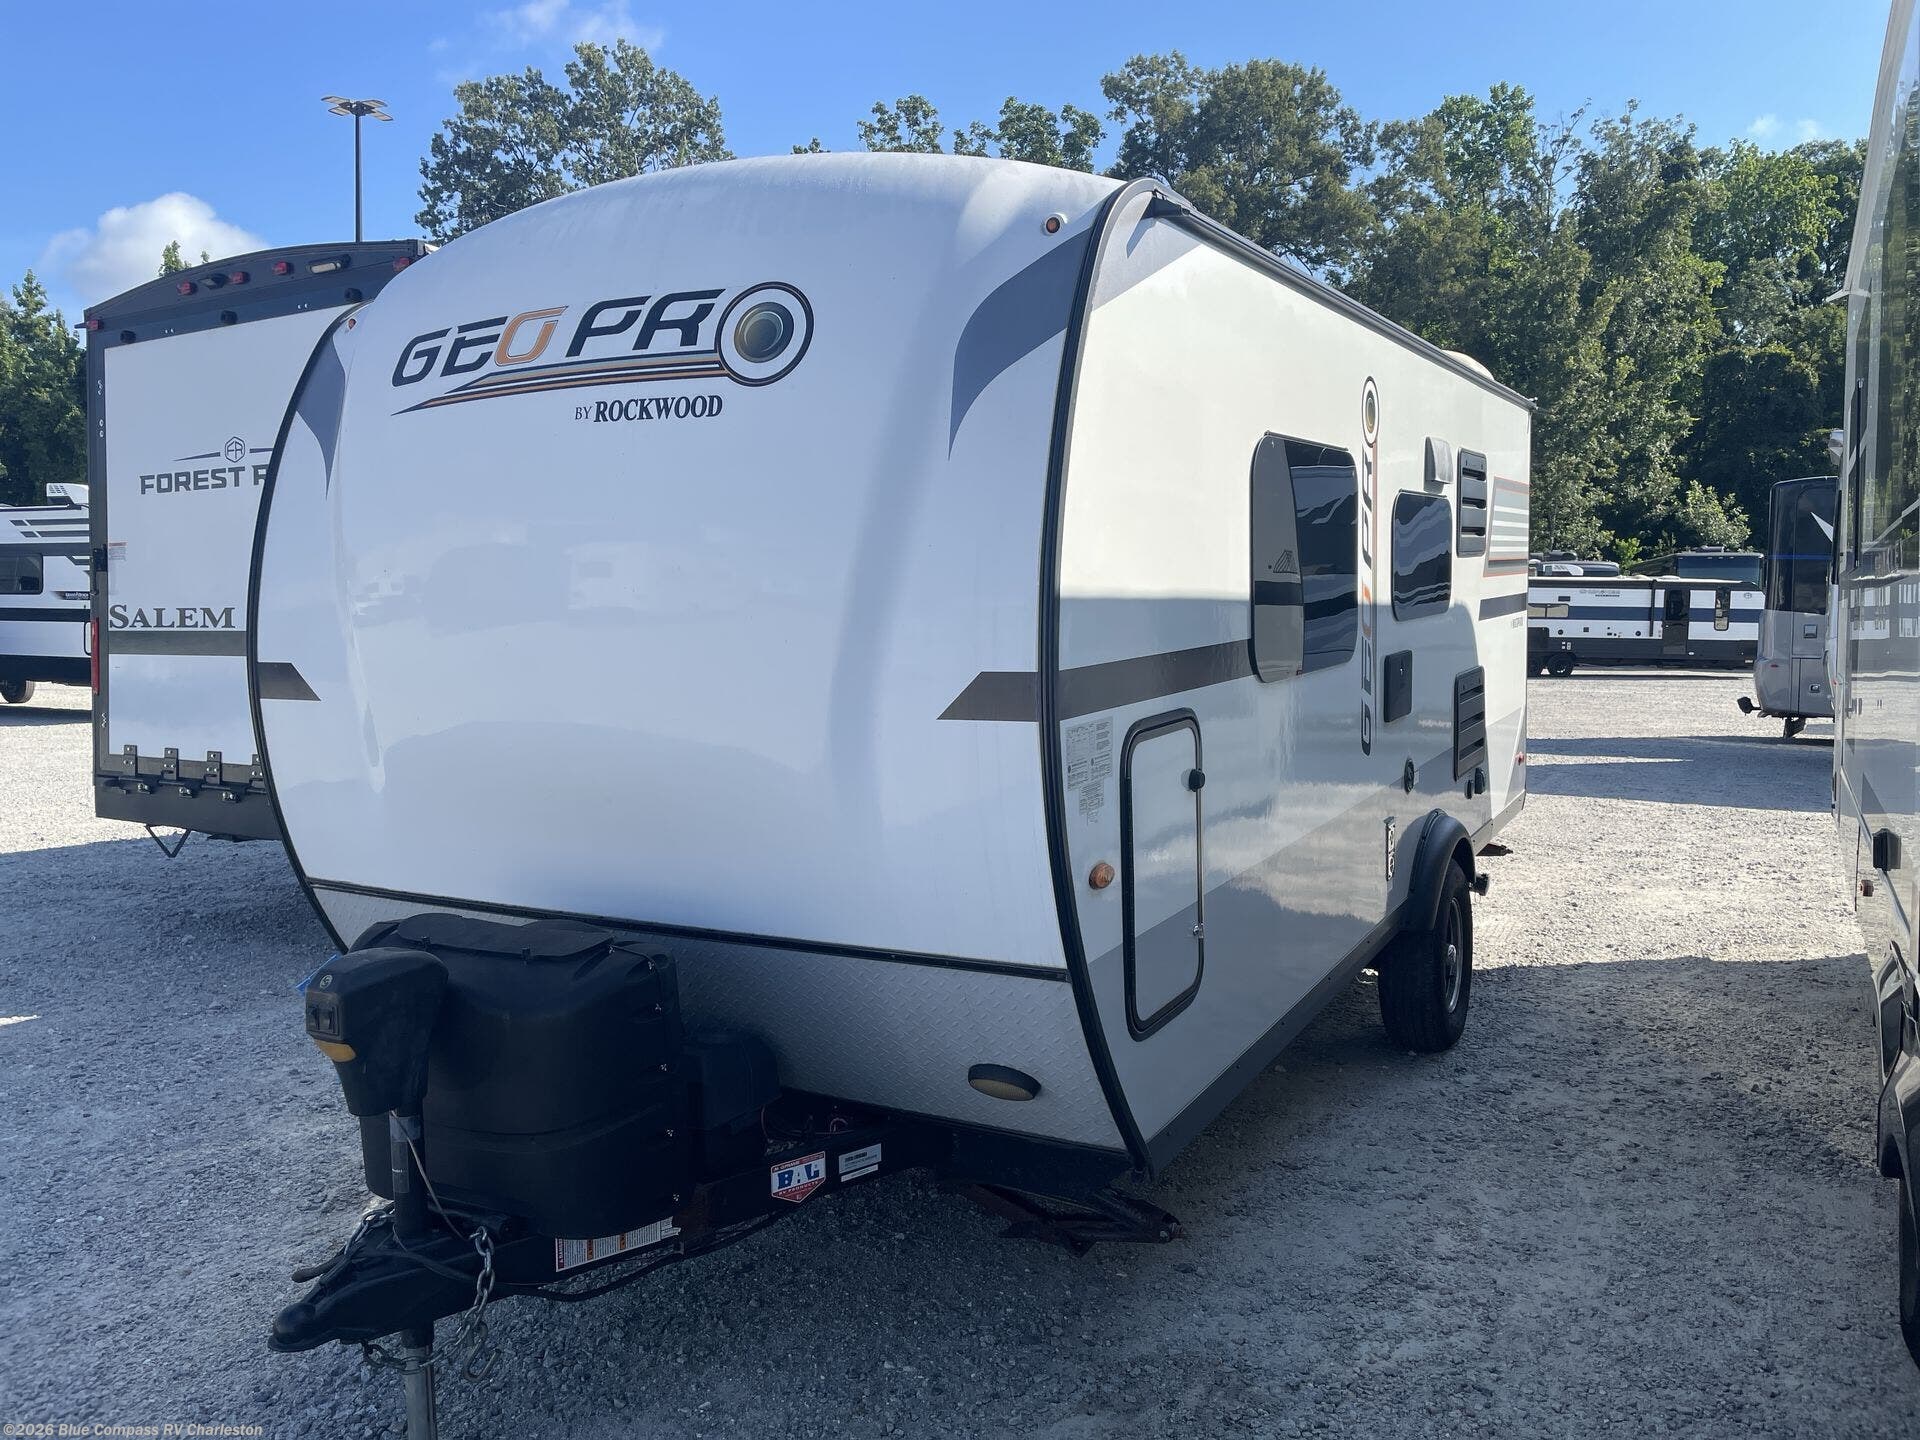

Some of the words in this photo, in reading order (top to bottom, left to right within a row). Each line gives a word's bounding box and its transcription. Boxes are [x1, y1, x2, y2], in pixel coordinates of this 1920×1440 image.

[392, 306, 569, 388] GEO
[575, 406, 593, 421] BY
[594, 395, 723, 423] ROCKWOOD
[139, 466, 246, 495] FOREST
[109, 604, 236, 629] SALEM
[777, 1163, 820, 1190] BAL
